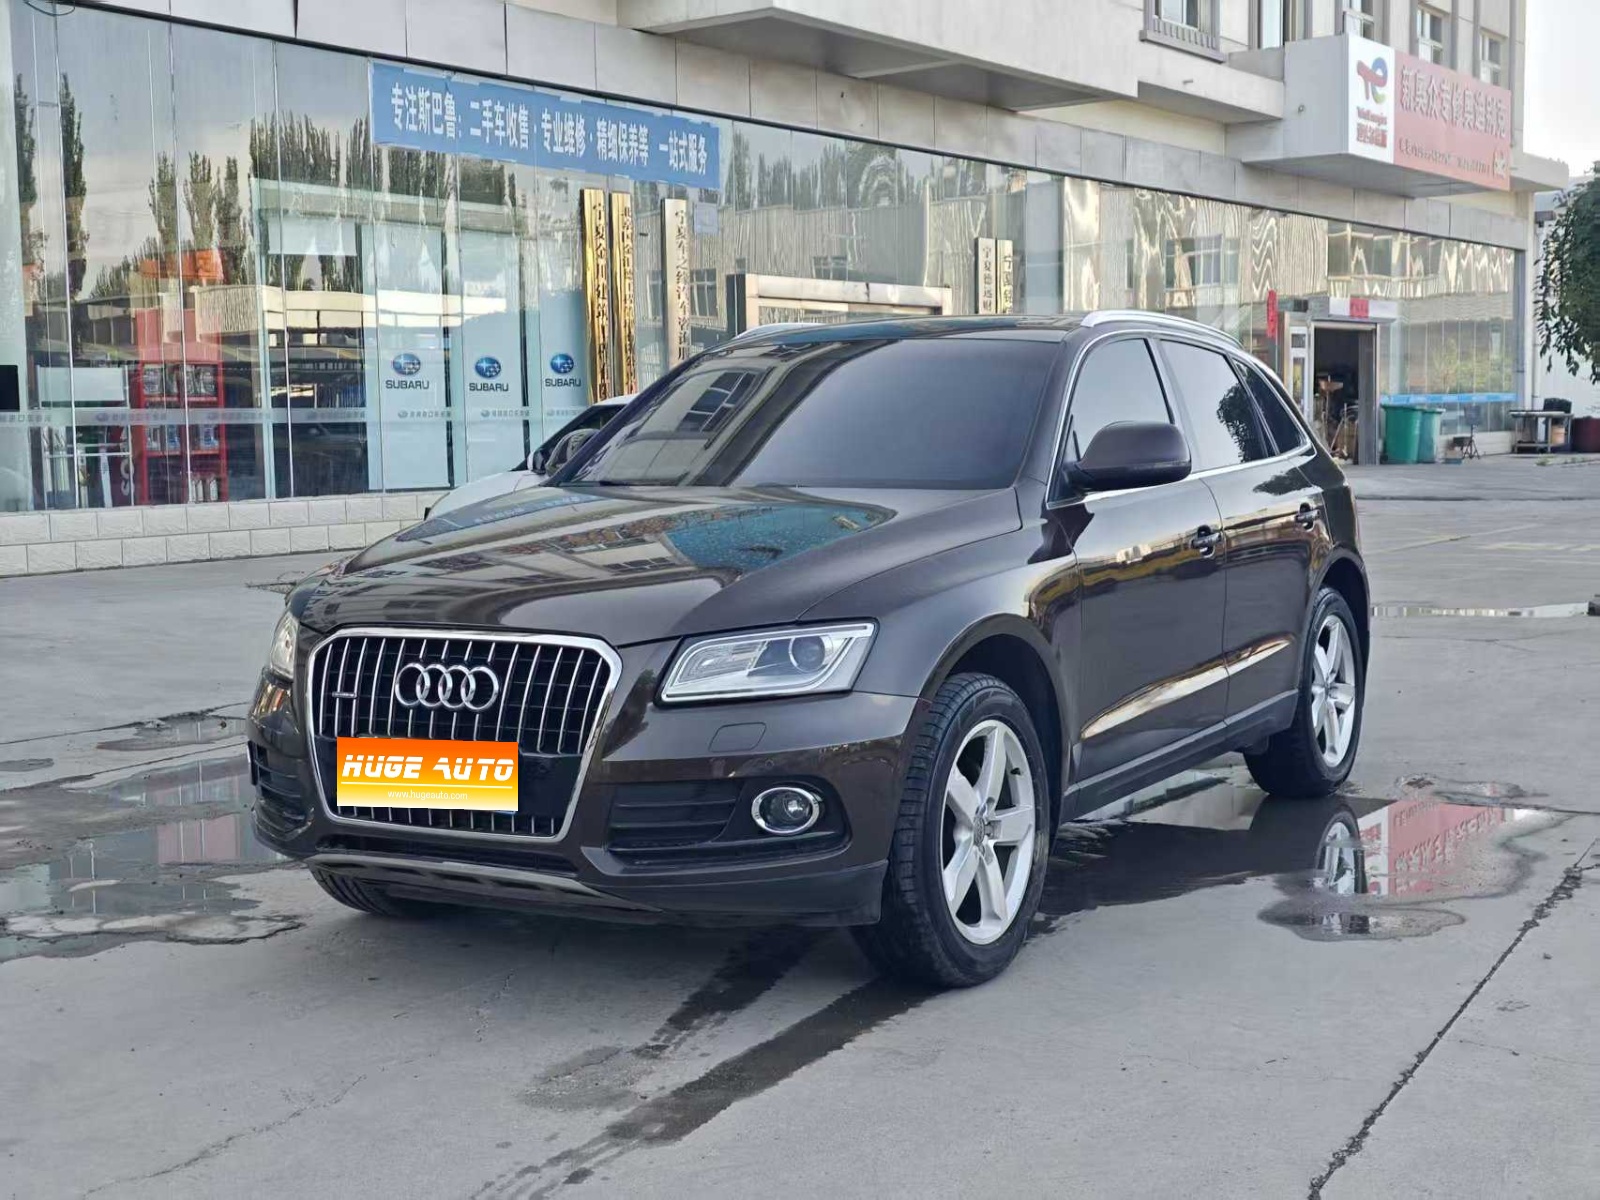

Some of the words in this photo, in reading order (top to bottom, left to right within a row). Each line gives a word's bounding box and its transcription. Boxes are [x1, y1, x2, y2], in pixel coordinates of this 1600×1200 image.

[659, 130, 707, 175] 一站式服务
[385, 380, 430, 390] SUBARU
[469, 382, 510, 392] SUBARU
[545, 378, 582, 388] SUBARU
